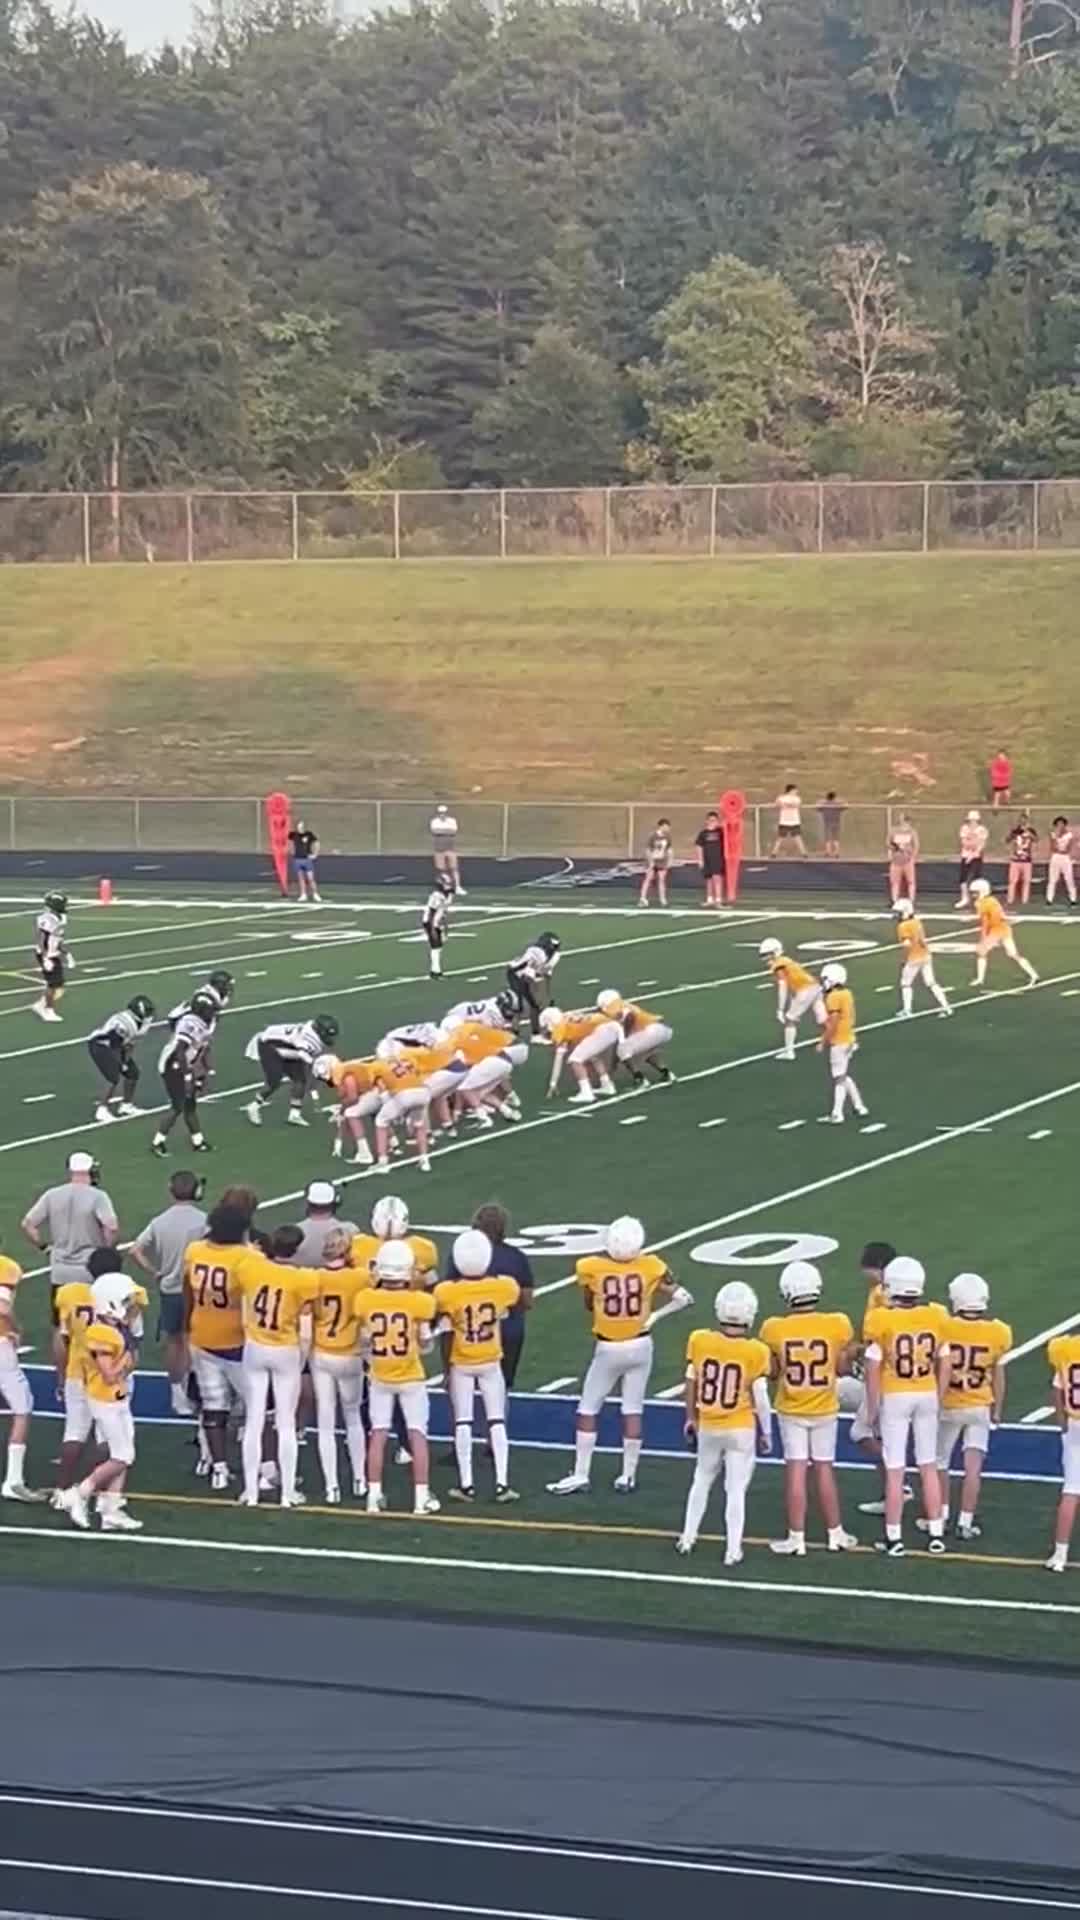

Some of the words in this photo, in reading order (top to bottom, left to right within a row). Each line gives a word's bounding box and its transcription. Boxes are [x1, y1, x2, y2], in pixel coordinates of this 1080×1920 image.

[194, 1263, 228, 1309] 79
[254, 1285, 283, 1330] 41
[603, 1273, 643, 1317] 88
[323, 1294, 342, 1338] 7
[370, 1312, 410, 1356] 23
[464, 1302, 497, 1343] 12
[785, 1339, 829, 1386] 52
[895, 1332, 937, 1379] 83
[948, 1343, 989, 1389] 25
[701, 1358, 742, 1409] 80
